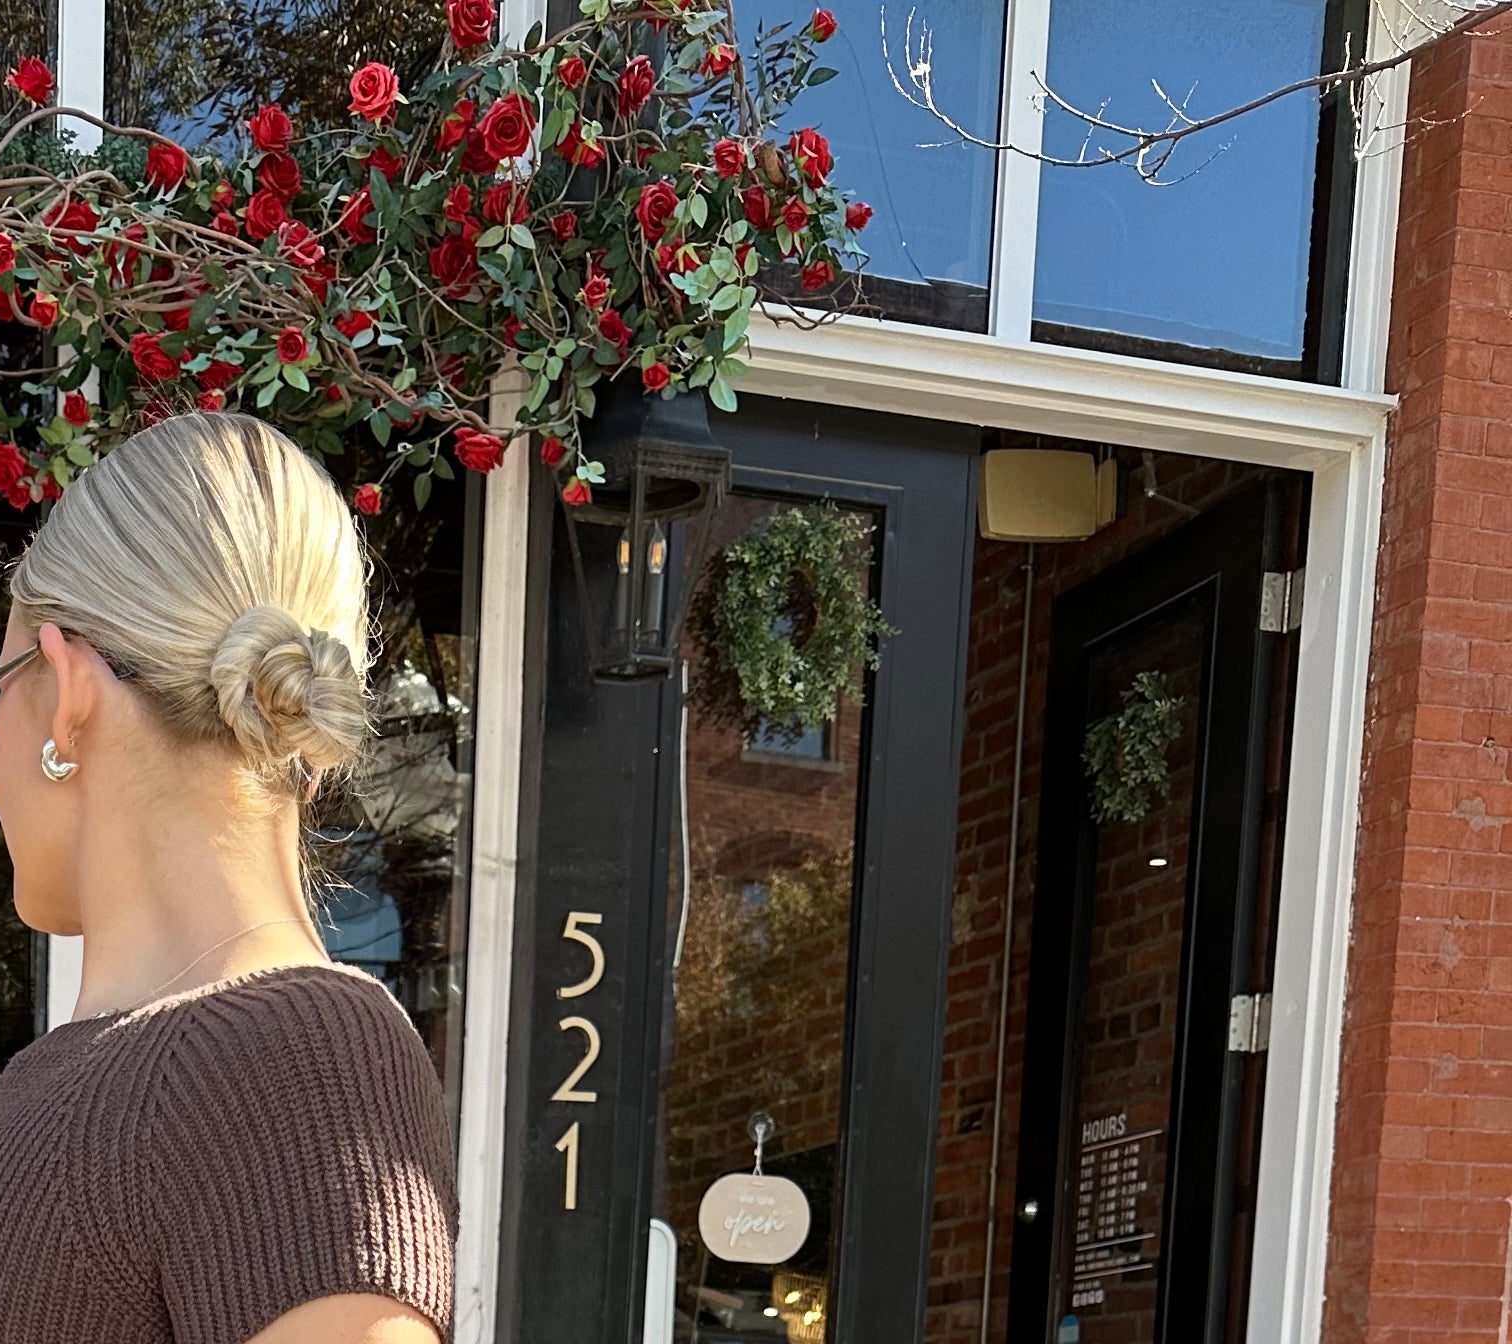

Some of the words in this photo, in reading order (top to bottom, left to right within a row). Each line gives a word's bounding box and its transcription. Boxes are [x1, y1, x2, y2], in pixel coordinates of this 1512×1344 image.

[551, 911, 605, 1210] 521
[1082, 1113, 1127, 1145] HOURS
[724, 1210, 786, 1247] open
